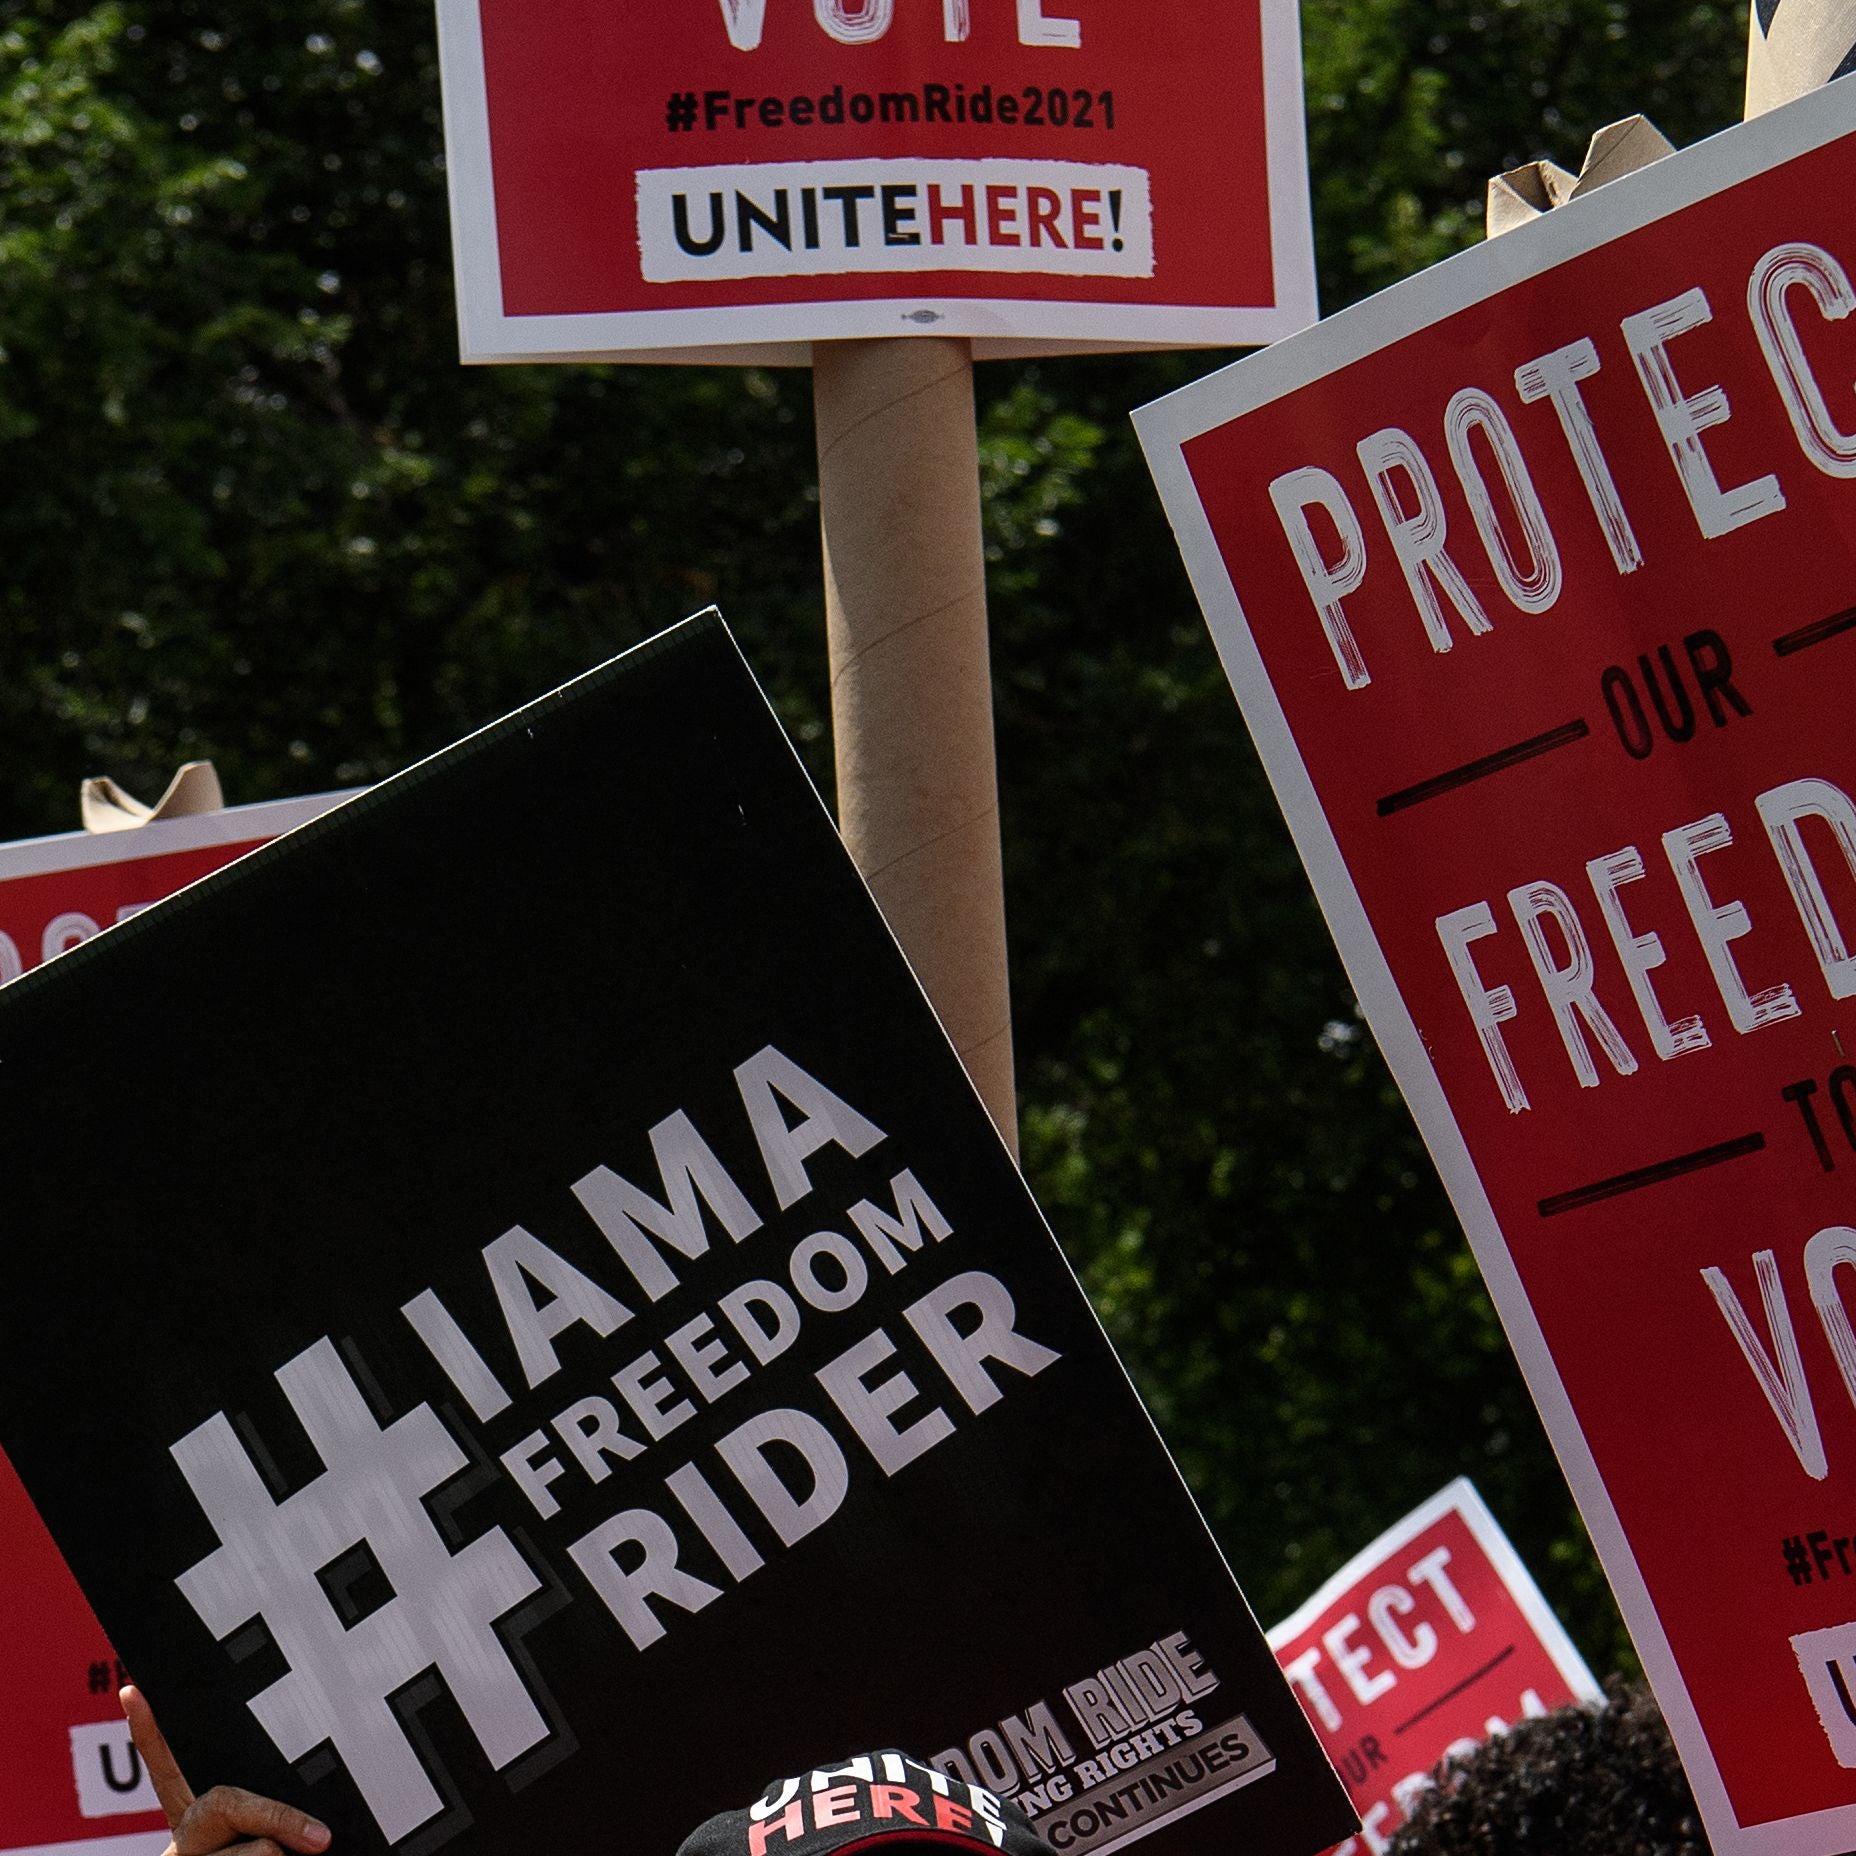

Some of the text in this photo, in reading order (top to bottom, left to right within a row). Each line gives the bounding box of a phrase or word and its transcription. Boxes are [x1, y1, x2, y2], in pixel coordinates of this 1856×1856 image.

[665, 83, 1116, 131] #FreedomRide2021
[671, 184, 1126, 256] UNITEHERE!
[1598, 627, 1754, 761] OUR
[497, 1166, 956, 1521] FREEDOM
[564, 1269, 1064, 1653] RIDER
[1061, 1630, 1222, 1750] RIDE
[1285, 1545, 1477, 1734] TECT
[1046, 1732, 1251, 1851] CONTINUES
[1072, 1708, 1204, 1789] RIGHTS
